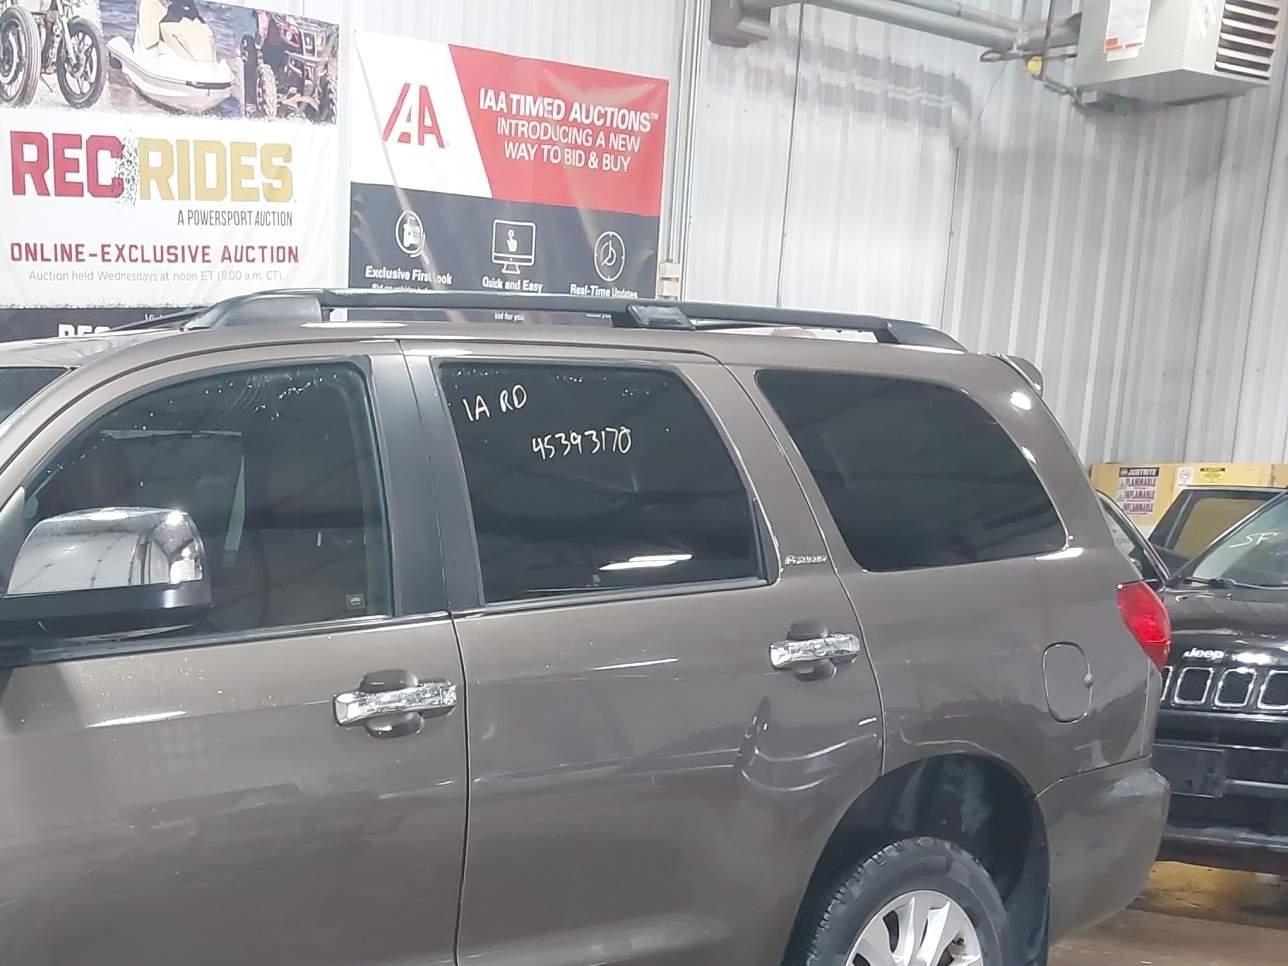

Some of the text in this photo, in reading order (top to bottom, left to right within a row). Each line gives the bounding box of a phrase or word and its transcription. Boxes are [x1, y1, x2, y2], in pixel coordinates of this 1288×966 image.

[478, 87, 508, 114] IAA
[509, 92, 566, 121] TIMED
[496, 116, 642, 153] INTRODUCING A NEW
[9, 130, 293, 203] REC RIDES
[503, 140, 632, 173] WAY TO BID & BUY
[177, 208, 293, 227] A POWERSPORT AUCTION
[9, 242, 300, 264] ONLINE-EXCLUSIVE AUCTION
[29, 270, 70, 281] Auction
[71, 270, 94, 281] held
[97, 270, 158, 284] Wednesdays
[160, 271, 169, 281] at
[172, 272, 198, 281] noon
[200, 270, 214, 281] ET
[364, 264, 411, 281] Exclusive
[411, 268, 432, 283] First
[481, 276, 544, 293] Quick and Easy
[569, 283, 611, 298] Real-Time
[499, 384, 528, 413] RD
[531, 426, 632, 461] 45393170
[1182, 648, 1225, 660] Jeep
